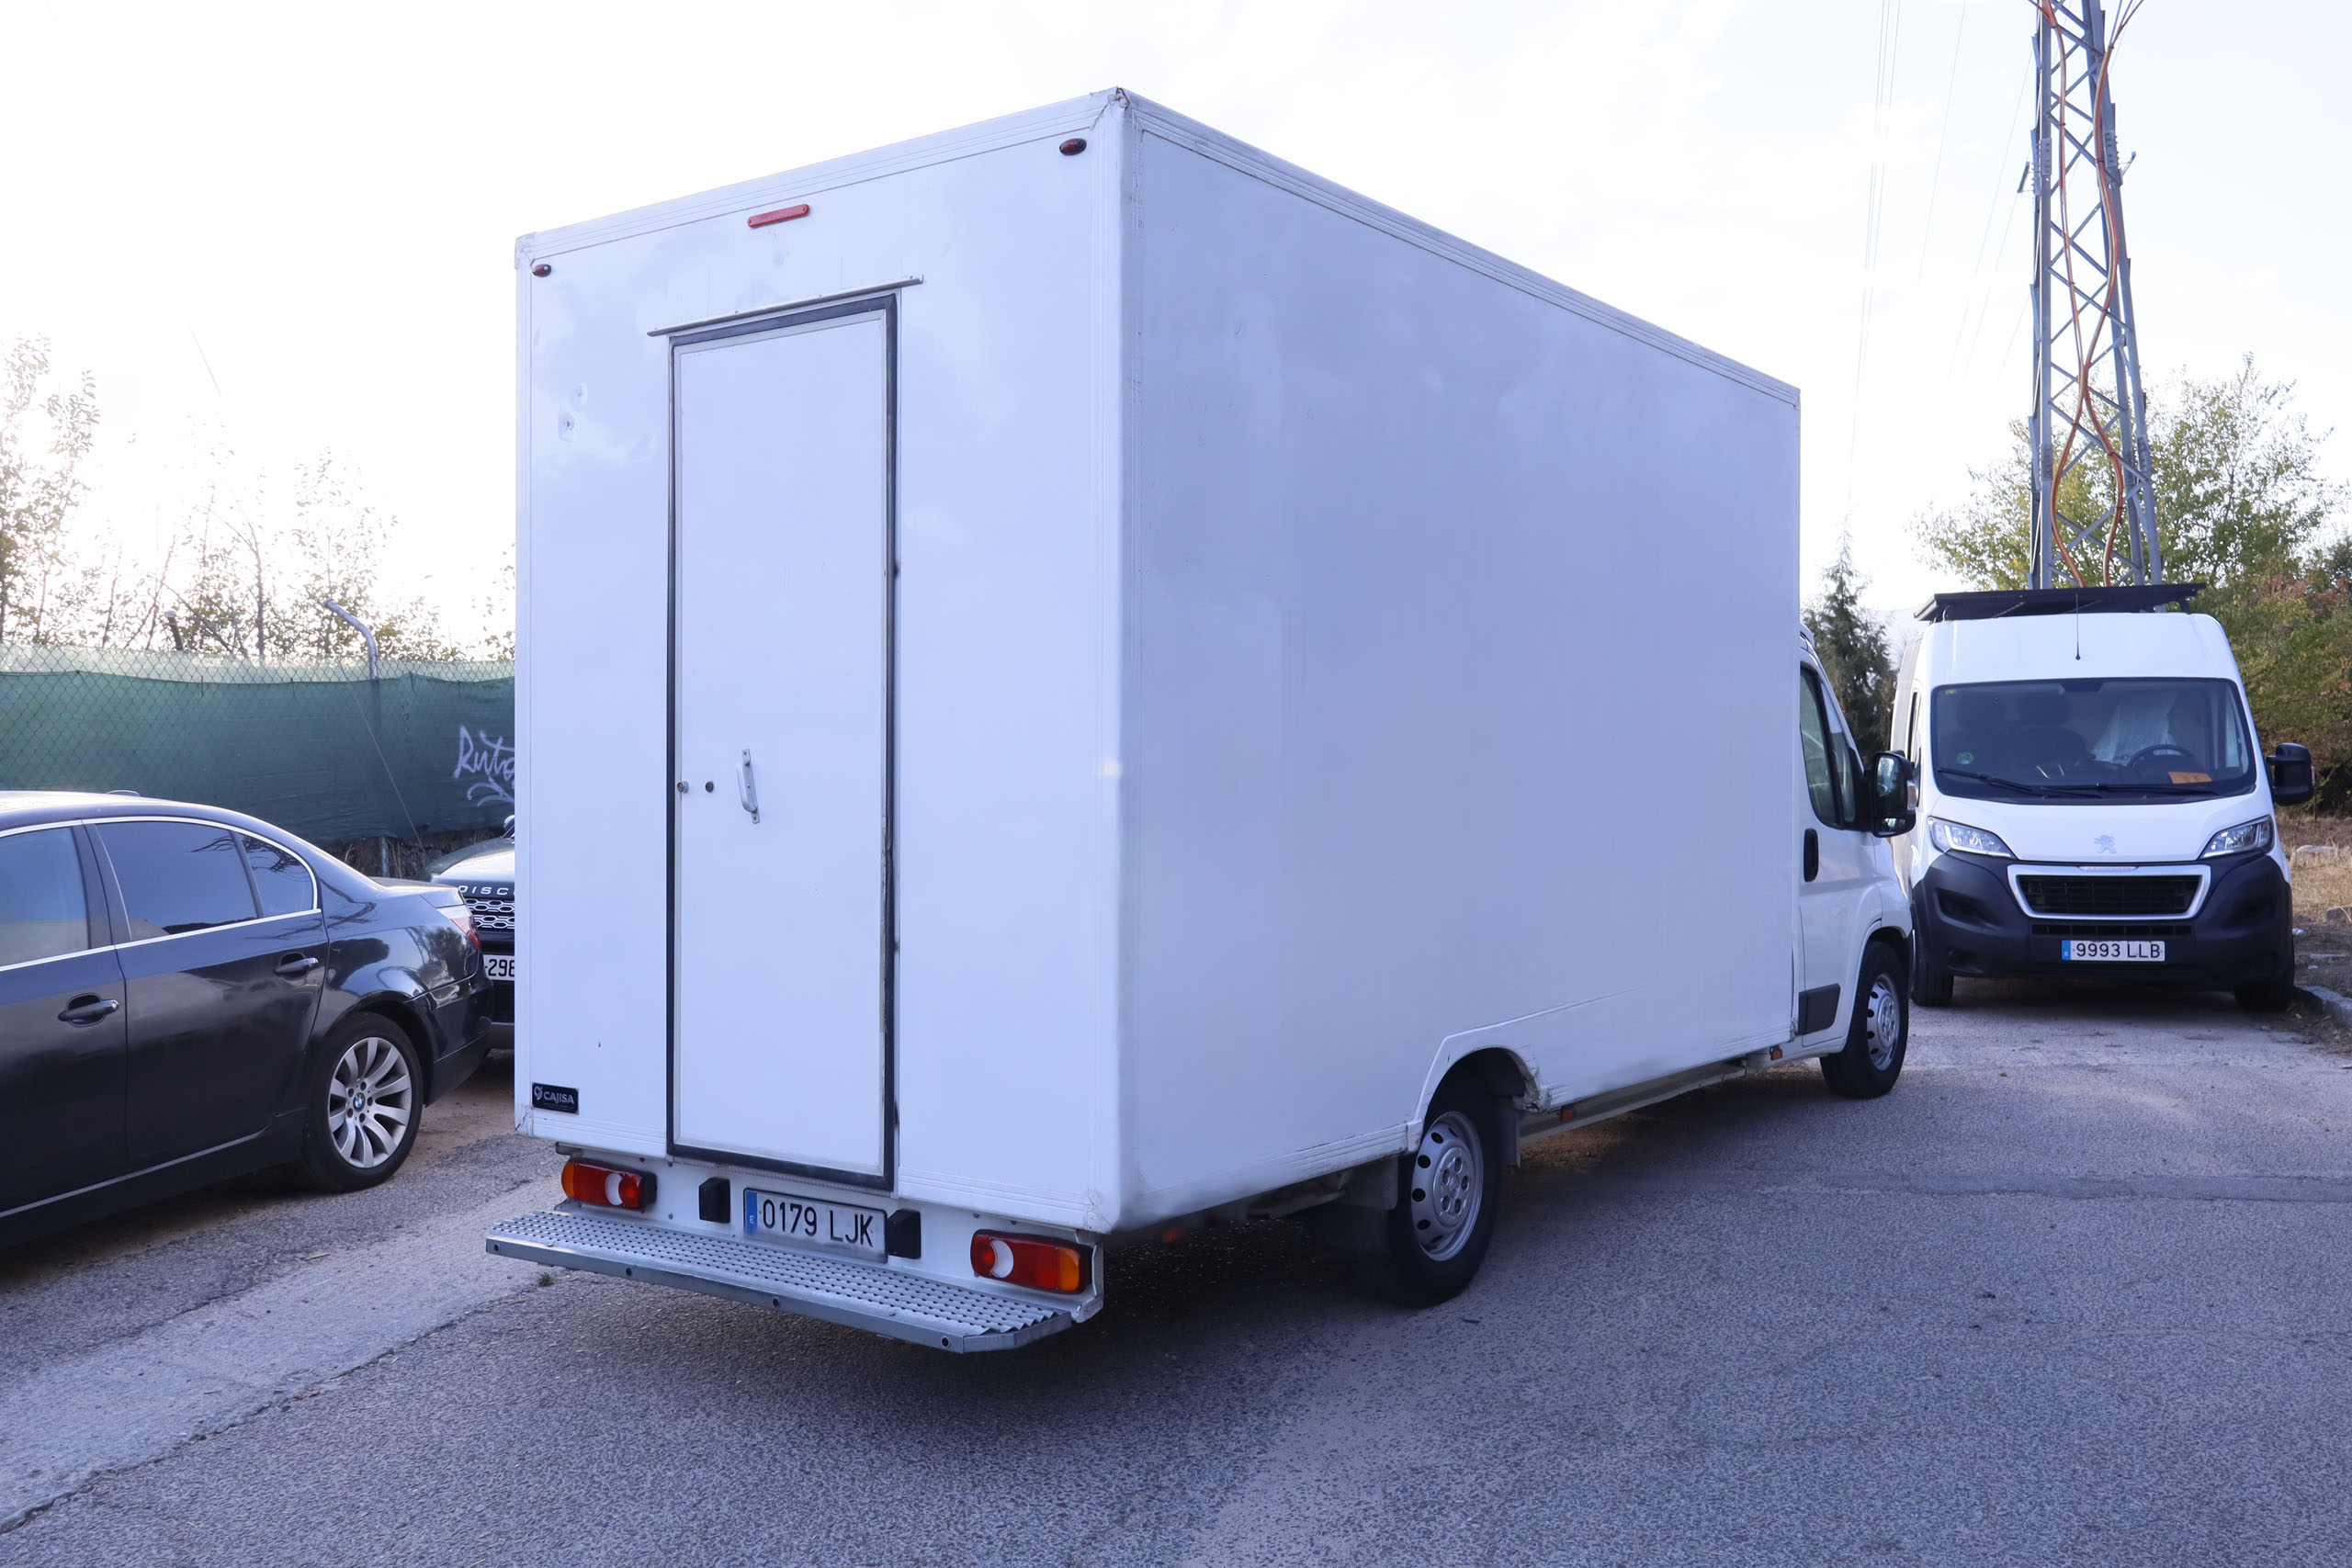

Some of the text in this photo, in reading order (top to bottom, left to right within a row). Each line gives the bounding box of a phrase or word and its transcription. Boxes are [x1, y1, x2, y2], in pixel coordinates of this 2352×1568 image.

[458, 885, 514, 897] DISC
[2076, 942, 2161, 958] 9993 LLB
[543, 1091, 575, 1105] CAJISA
[749, 1214, 755, 1224] E
[763, 1199, 874, 1247] 0179 LJK
